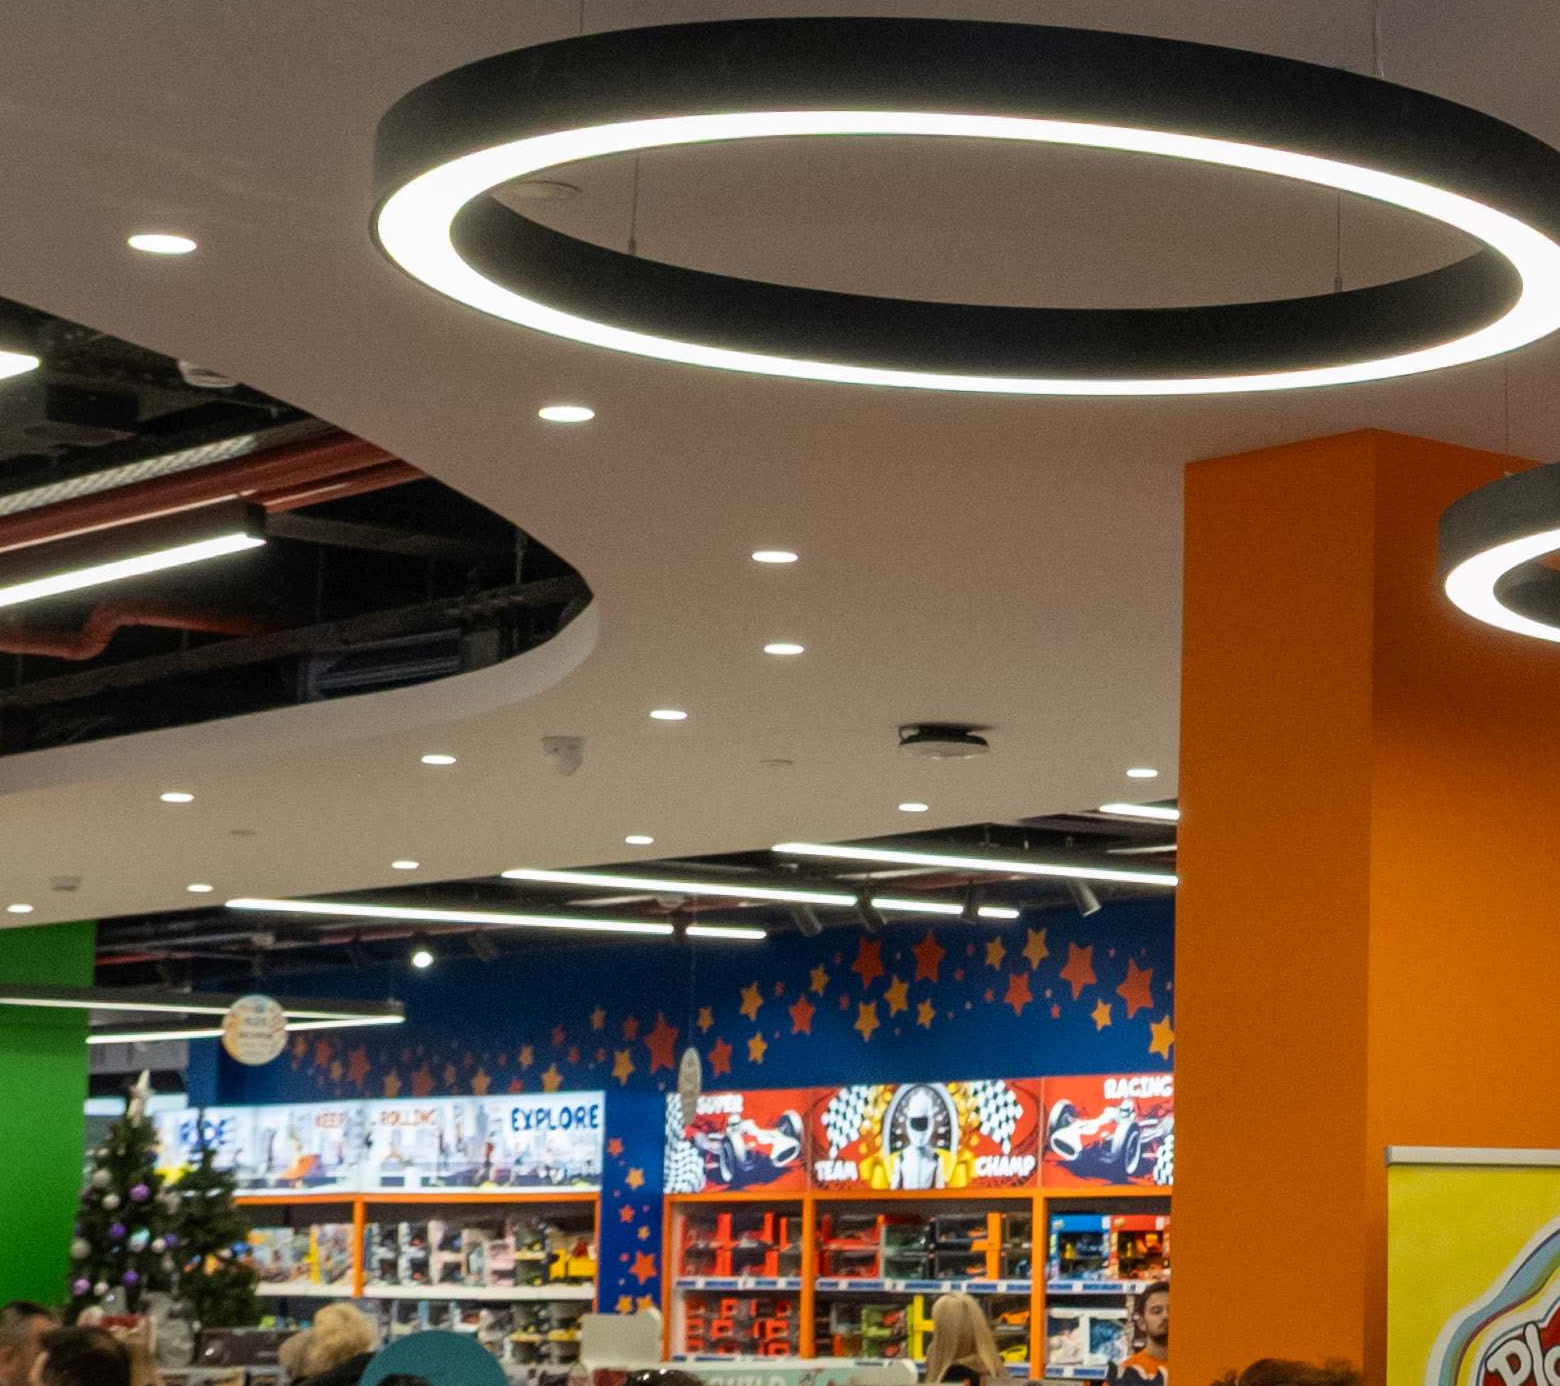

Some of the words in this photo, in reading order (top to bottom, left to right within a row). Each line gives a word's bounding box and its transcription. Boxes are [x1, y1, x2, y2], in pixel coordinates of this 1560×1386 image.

[1103, 1076, 1173, 1100] RACING
[696, 1095, 744, 1115] SUPER
[511, 1104, 600, 1131] EXPLORE
[814, 1160, 858, 1182] TEAM
[976, 1155, 1036, 1178] CHAMP
